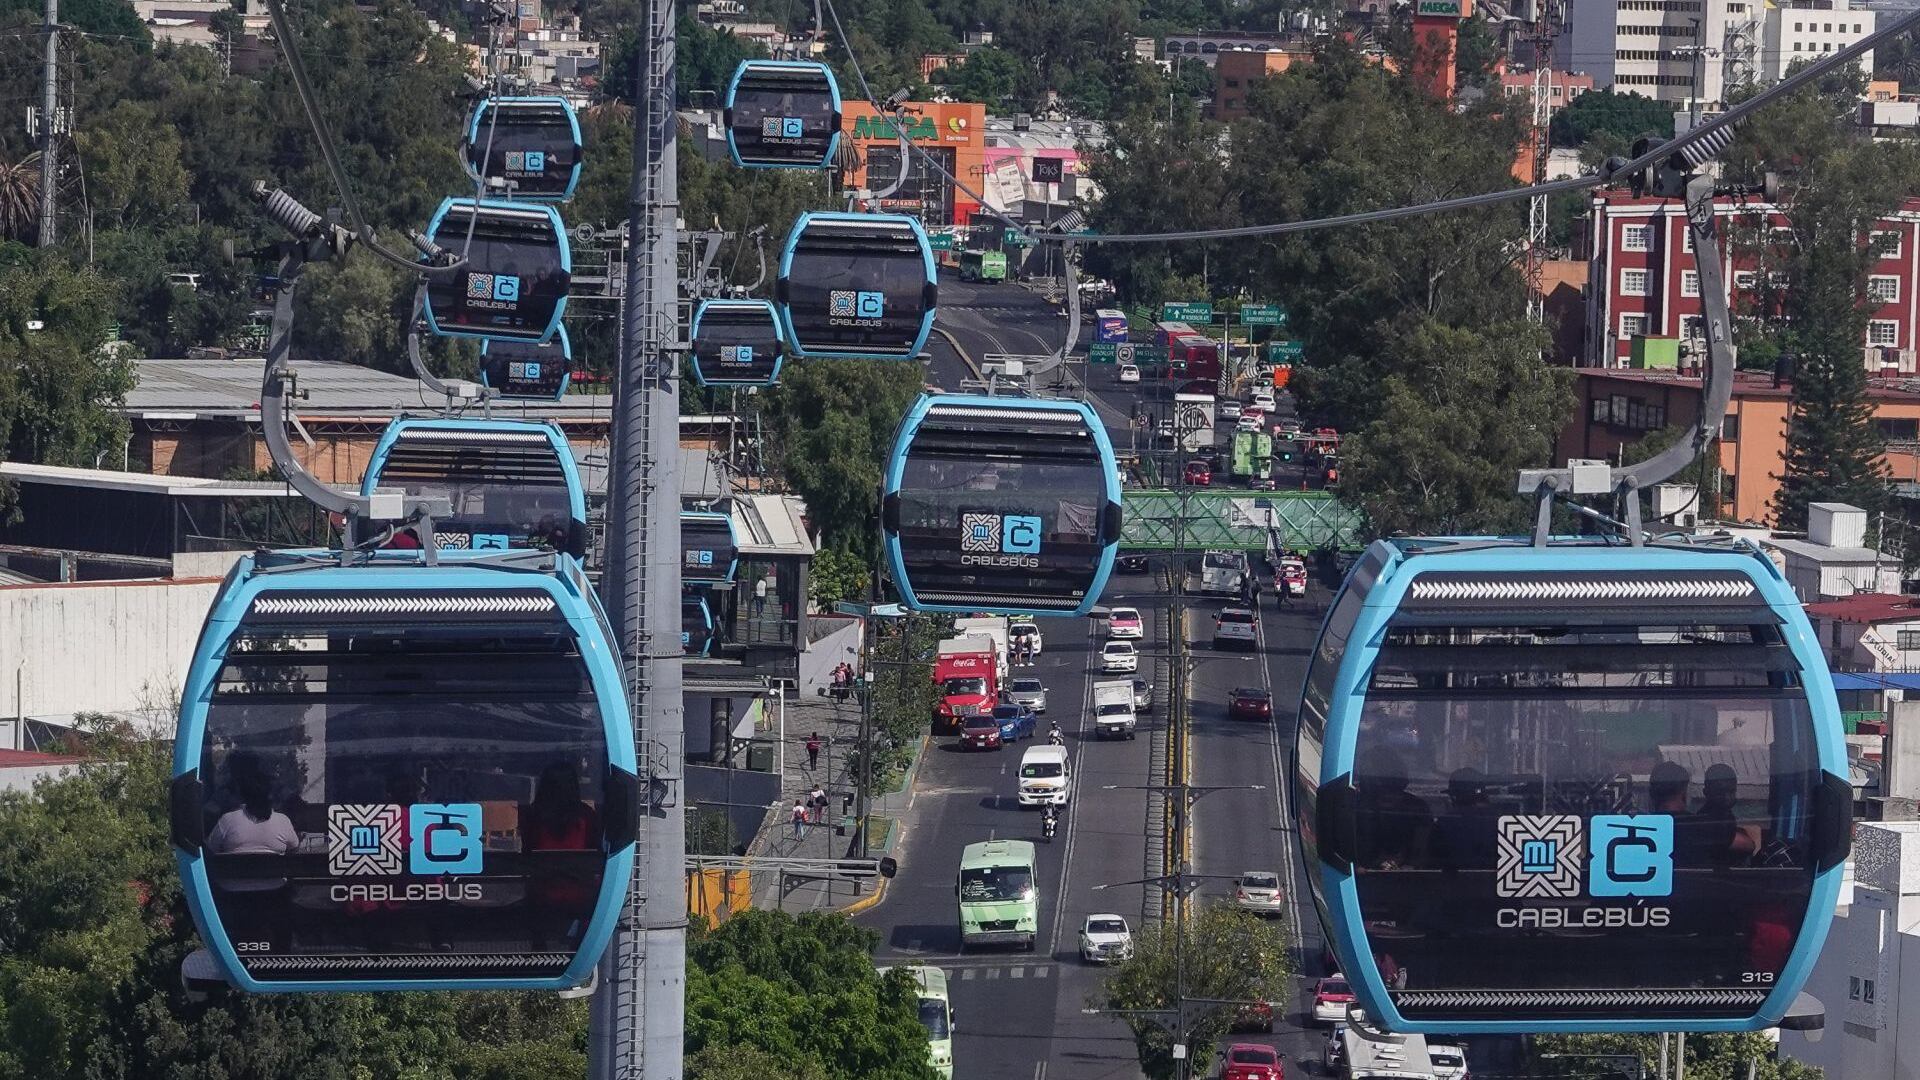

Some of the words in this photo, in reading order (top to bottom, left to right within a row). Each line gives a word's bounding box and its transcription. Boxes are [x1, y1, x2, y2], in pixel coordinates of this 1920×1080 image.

[1420, 2, 1458, 12] MEGA
[853, 115, 939, 140] MEGA
[331, 877, 482, 902] CABLEBÚS
[1497, 899, 1670, 928] CABLEBÚS
[237, 942, 270, 951] 338
[1741, 972, 1774, 983] 313
